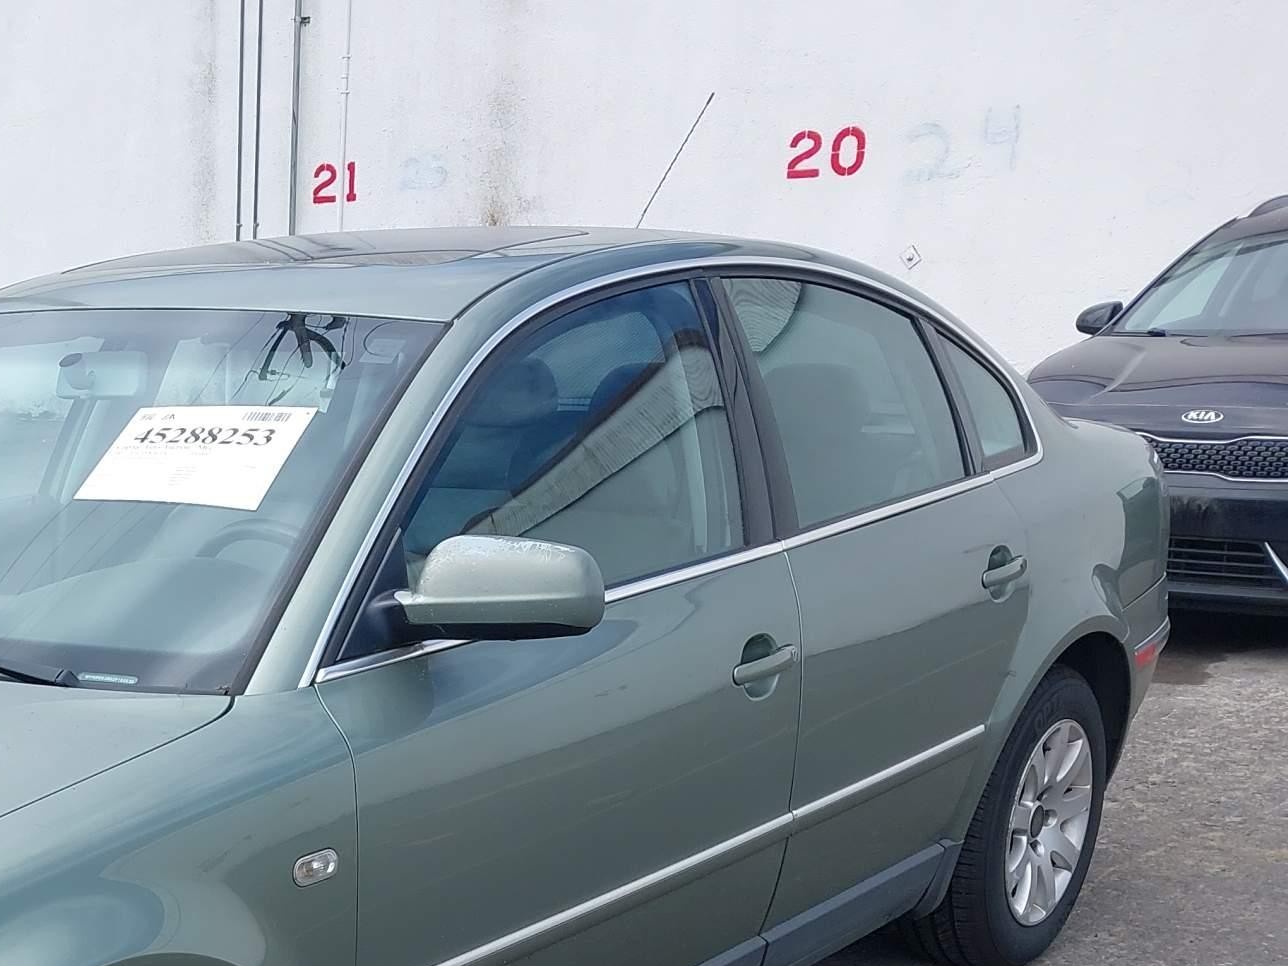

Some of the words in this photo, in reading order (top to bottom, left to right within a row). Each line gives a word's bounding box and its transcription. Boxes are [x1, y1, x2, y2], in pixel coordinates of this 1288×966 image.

[786, 126, 867, 179] 20
[312, 161, 357, 204] 21
[1187, 410, 1216, 420] KIA
[133, 426, 277, 446] 45288253
